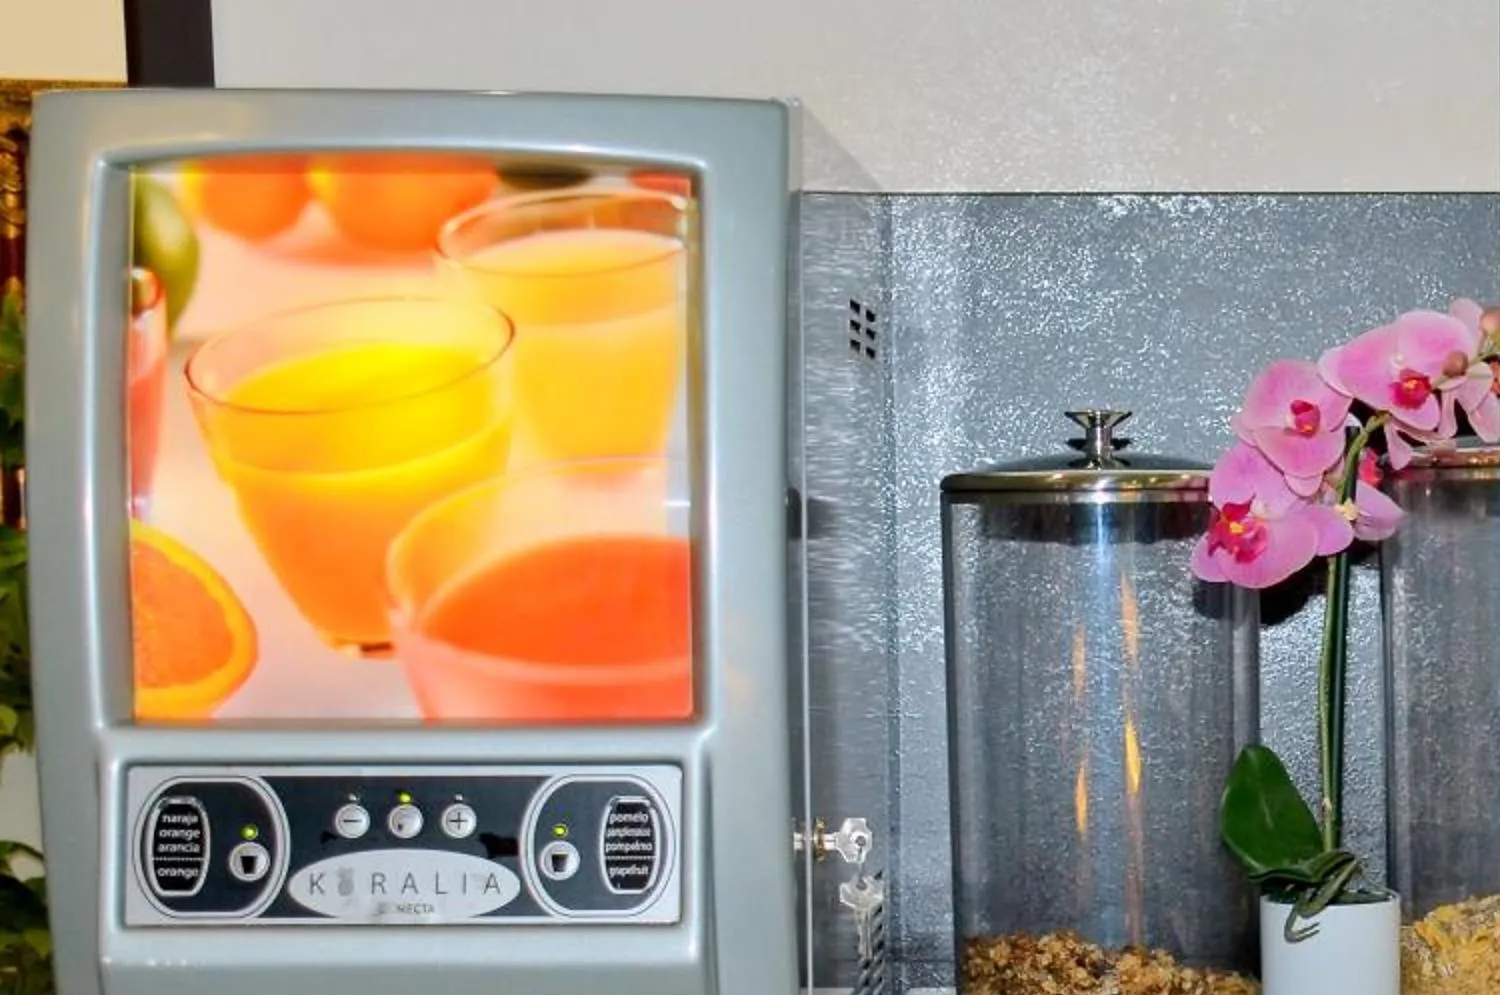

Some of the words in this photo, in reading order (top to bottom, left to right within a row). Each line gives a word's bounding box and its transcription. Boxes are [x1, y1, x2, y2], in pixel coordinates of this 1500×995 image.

[159, 829, 200, 841] orange
[158, 842, 200, 852] arancia
[397, 903, 435, 914] NECTA
